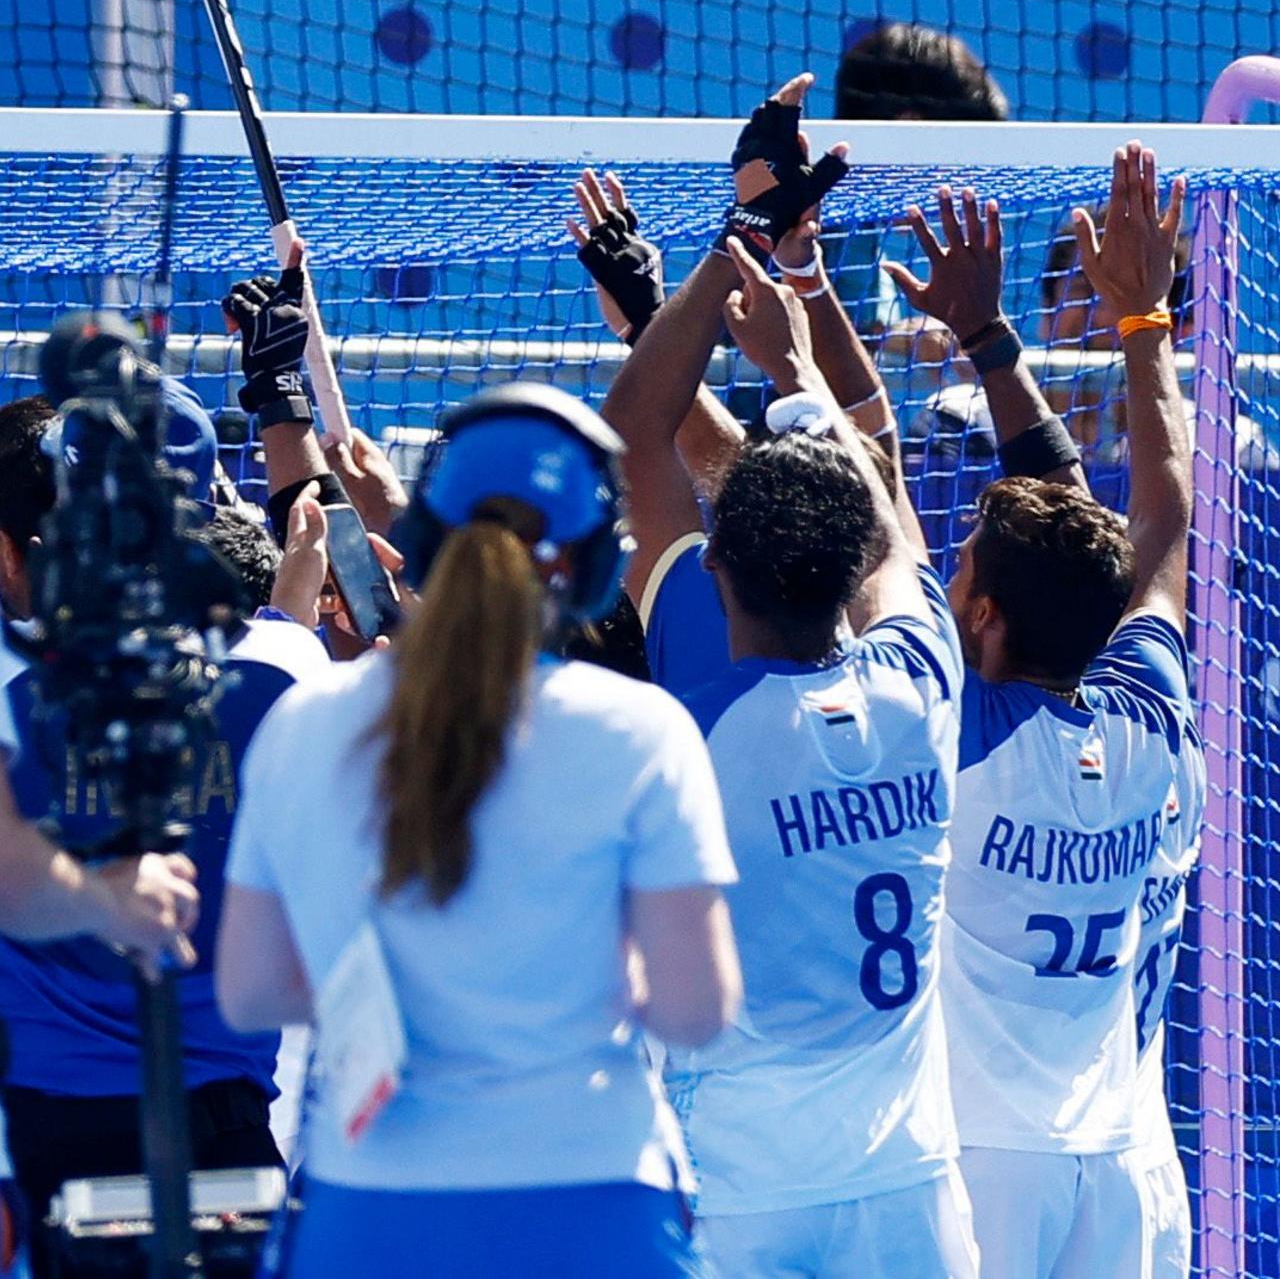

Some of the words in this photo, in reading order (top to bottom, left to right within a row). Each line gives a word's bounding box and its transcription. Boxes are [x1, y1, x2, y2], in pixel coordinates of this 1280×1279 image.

[770, 769, 939, 857] HARDIK
[853, 872, 918, 1011] 8
[1024, 907, 1126, 979] 25
